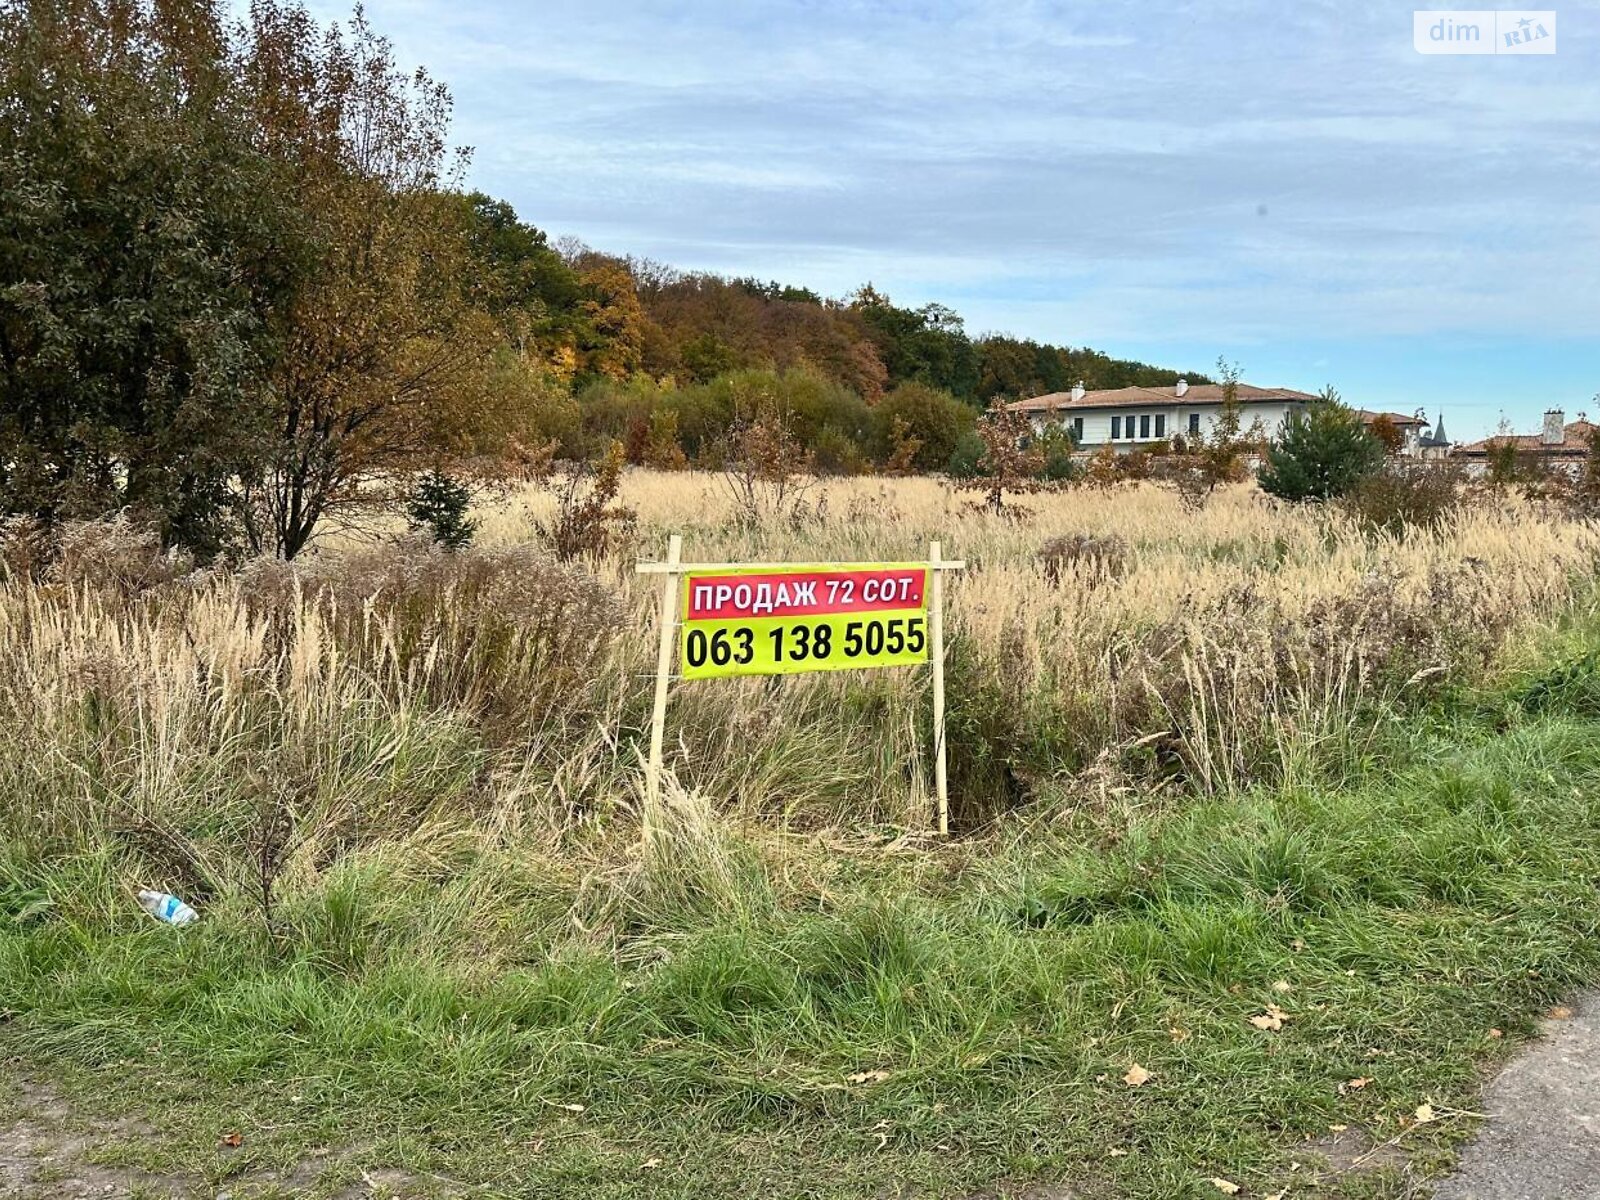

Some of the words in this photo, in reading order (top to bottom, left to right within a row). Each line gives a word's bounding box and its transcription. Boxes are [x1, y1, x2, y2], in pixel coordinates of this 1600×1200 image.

[694, 581, 817, 614] ПРОДАЖ
[826, 580, 855, 604] 72
[863, 578, 919, 603] СОТ.
[686, 627, 754, 667] 063
[768, 624, 832, 662] 138
[844, 618, 925, 657] 5055
